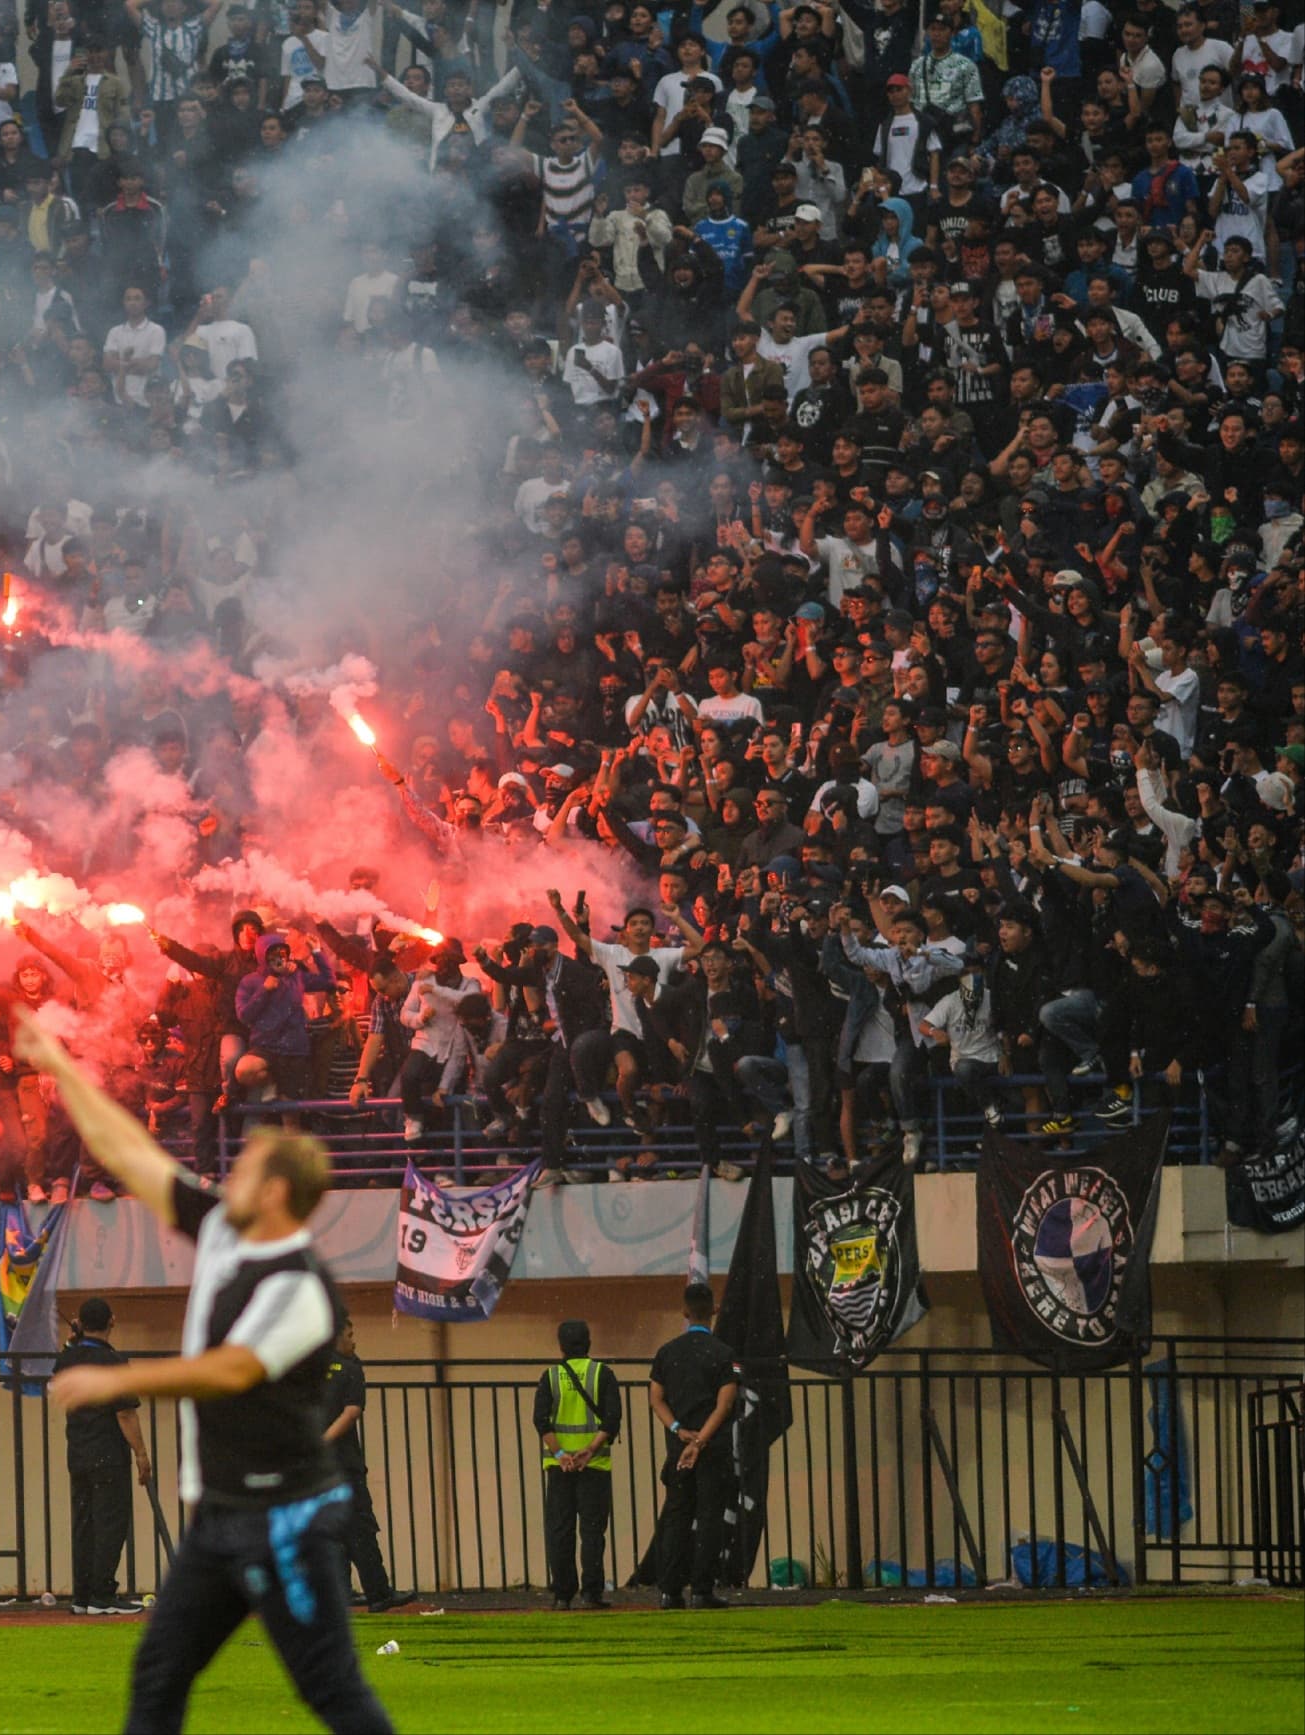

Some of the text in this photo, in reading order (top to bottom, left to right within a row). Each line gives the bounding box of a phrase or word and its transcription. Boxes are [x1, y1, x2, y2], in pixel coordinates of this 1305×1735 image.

[1020, 1178, 1057, 1238] WHAT
[400, 1223, 427, 1254] 19
[417, 1289, 446, 1308] HIGH
[449, 1296, 462, 1309] &
[1021, 1262, 1070, 1332] HERE
[1076, 1317, 1106, 1338] TO
